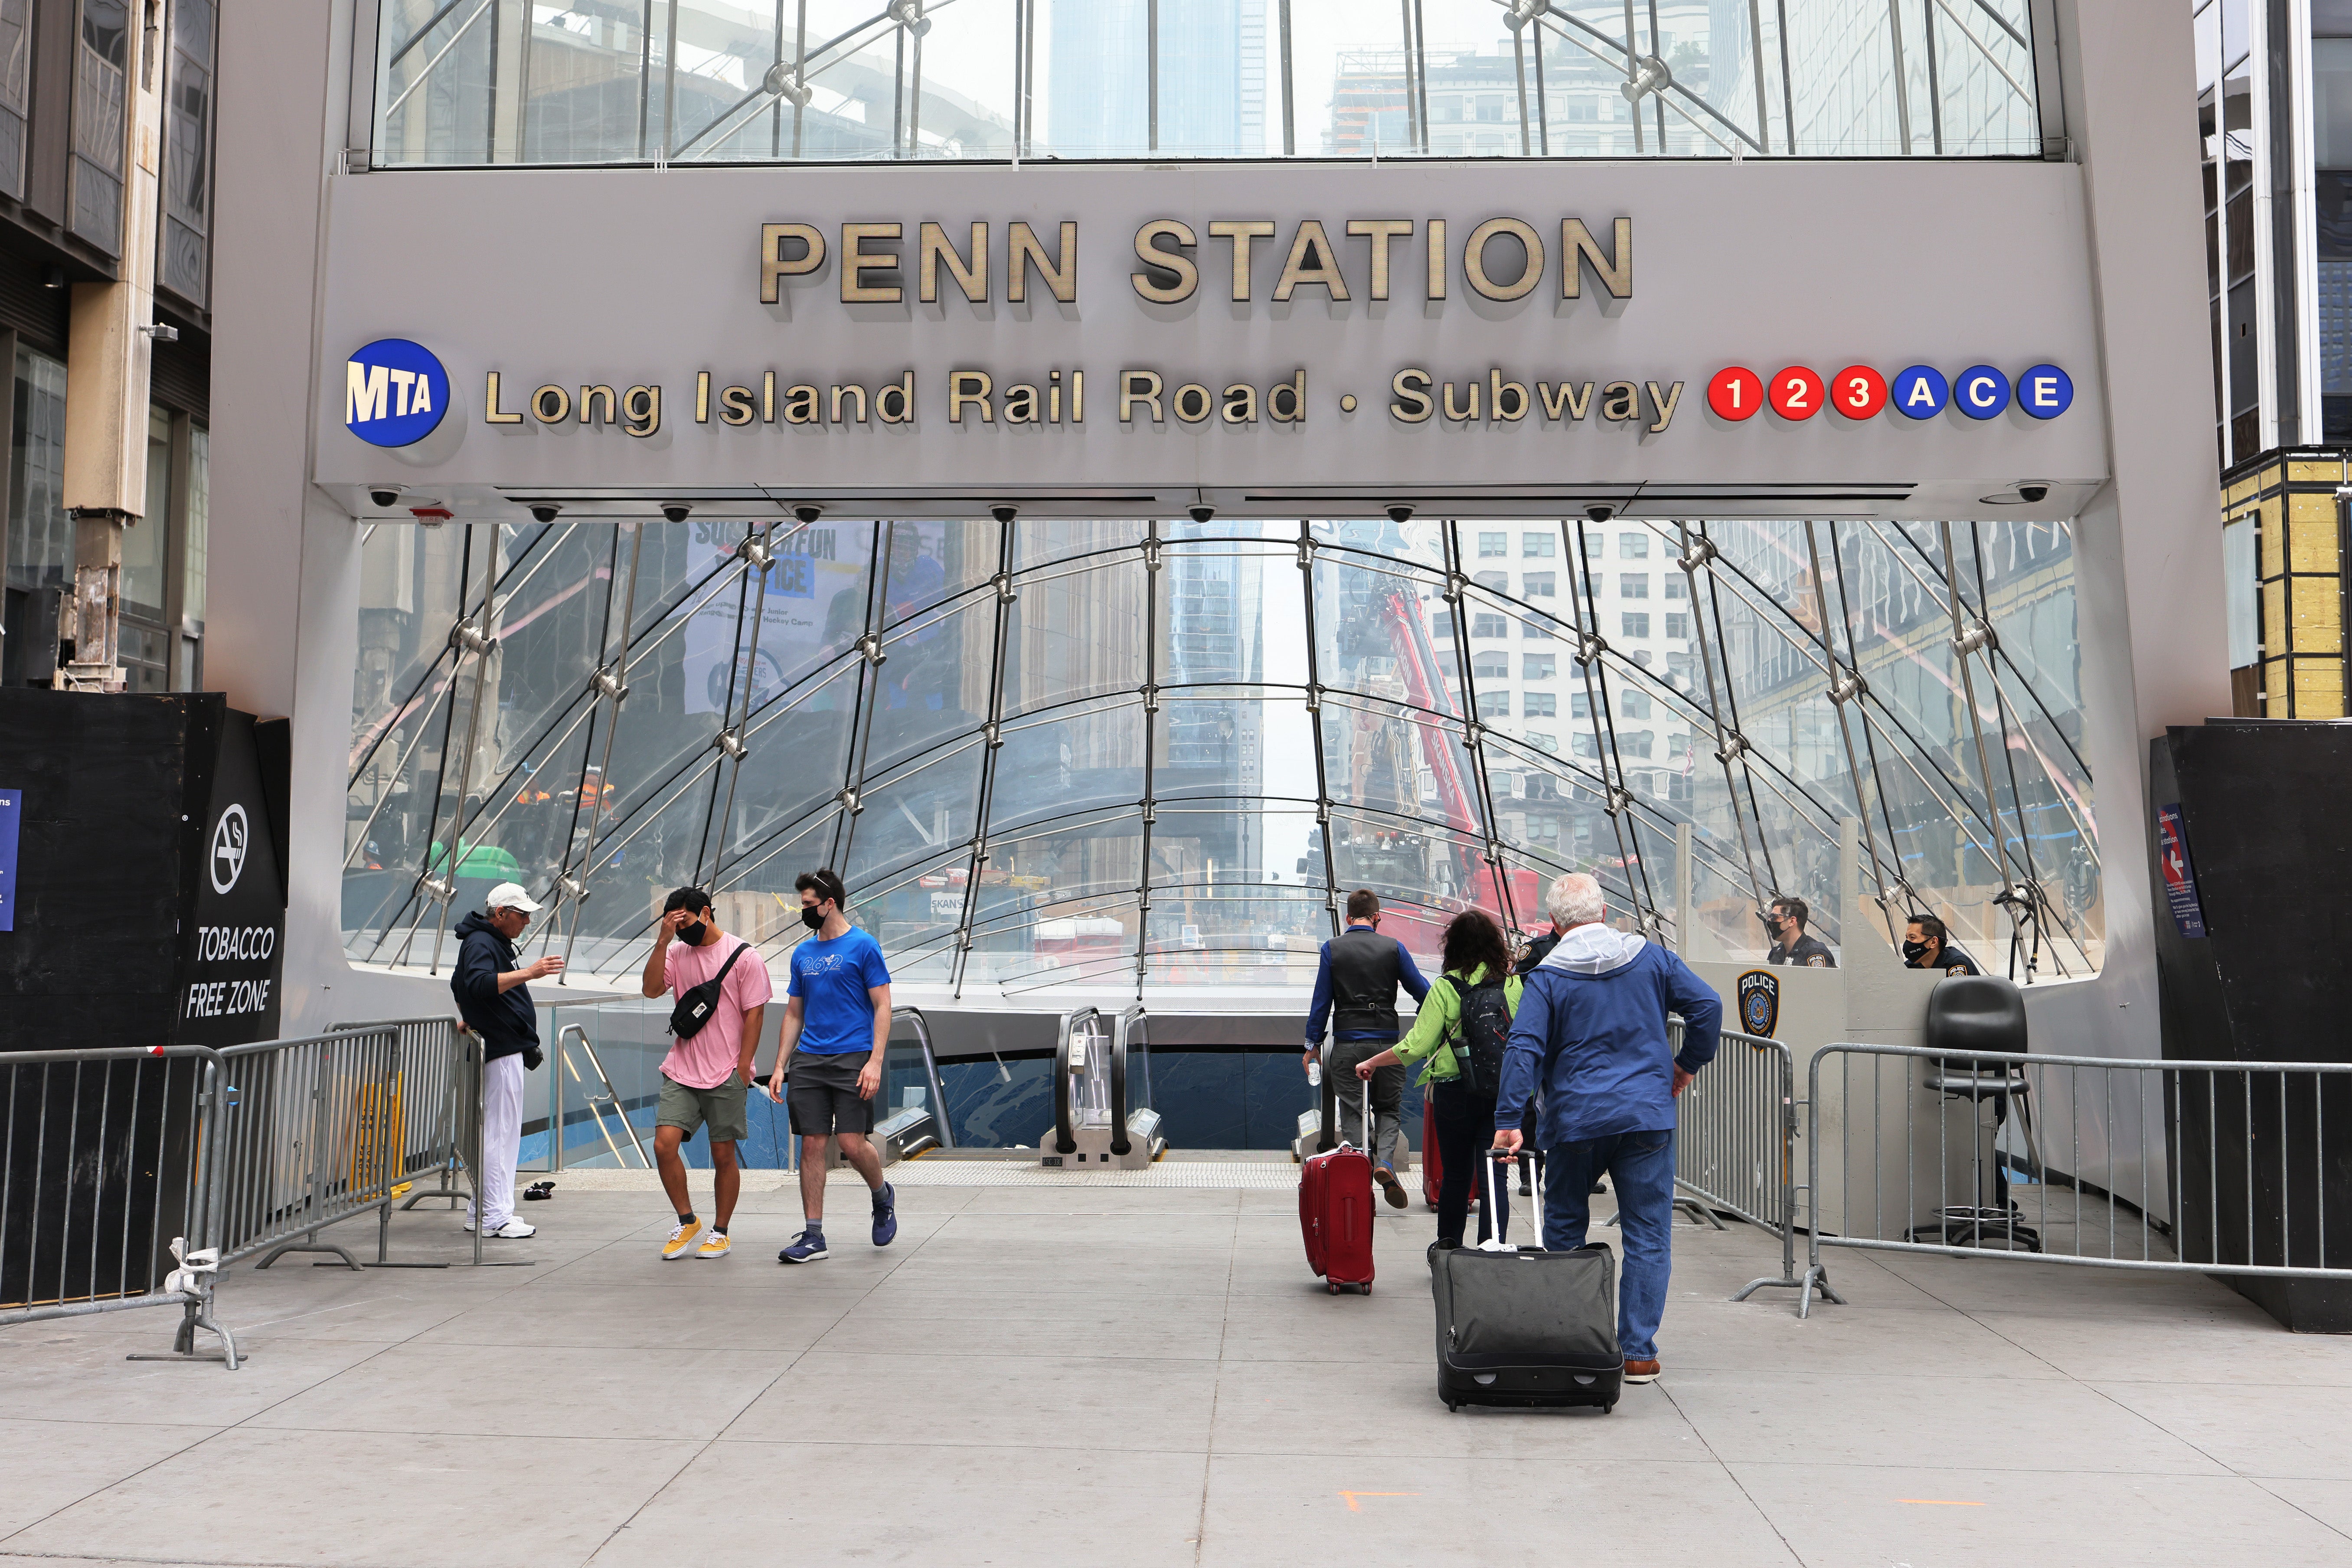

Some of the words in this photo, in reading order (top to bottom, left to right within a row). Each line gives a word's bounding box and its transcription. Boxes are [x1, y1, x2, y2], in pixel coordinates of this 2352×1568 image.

[760, 221, 1077, 304] PENN
[1130, 216, 1633, 304] STATION
[346, 360, 431, 425] MTA
[485, 371, 661, 437] Long
[695, 370, 914, 425] Island
[948, 369, 1085, 424] Rail
[1119, 369, 1306, 424] Road
[1389, 368, 1684, 434] Subway
[1727, 379, 1741, 408] 1
[1787, 379, 1807, 408] 2
[1848, 378, 1870, 408] 3
[1907, 377, 1936, 407] A
[1969, 377, 1996, 408] C
[2034, 377, 2058, 407] E
[796, 529, 836, 561] FUN
[774, 558, 807, 594] ICE
[763, 616, 789, 625] Hockey
[791, 618, 813, 627] Camp
[767, 607, 789, 616] Junior
[1395, 632, 1412, 686] MAGNI
[1431, 730, 1454, 806] SKANSKA
[2164, 836, 2178, 845] station
[931, 898, 972, 909] SKANSA
[197, 926, 274, 961] TOBACCO
[802, 954, 843, 972] 26.2
[1950, 967, 1965, 976] POLICE
[186, 982, 226, 1019] FREE
[225, 979, 271, 1015] ZONE
[1742, 974, 1775, 996] POLICE
[1747, 993, 1757, 1022] METROPOLITAN
[1757, 993, 1770, 1023] TRANSPORTATION
[1751, 1022, 1766, 1030] AUTHORITY
